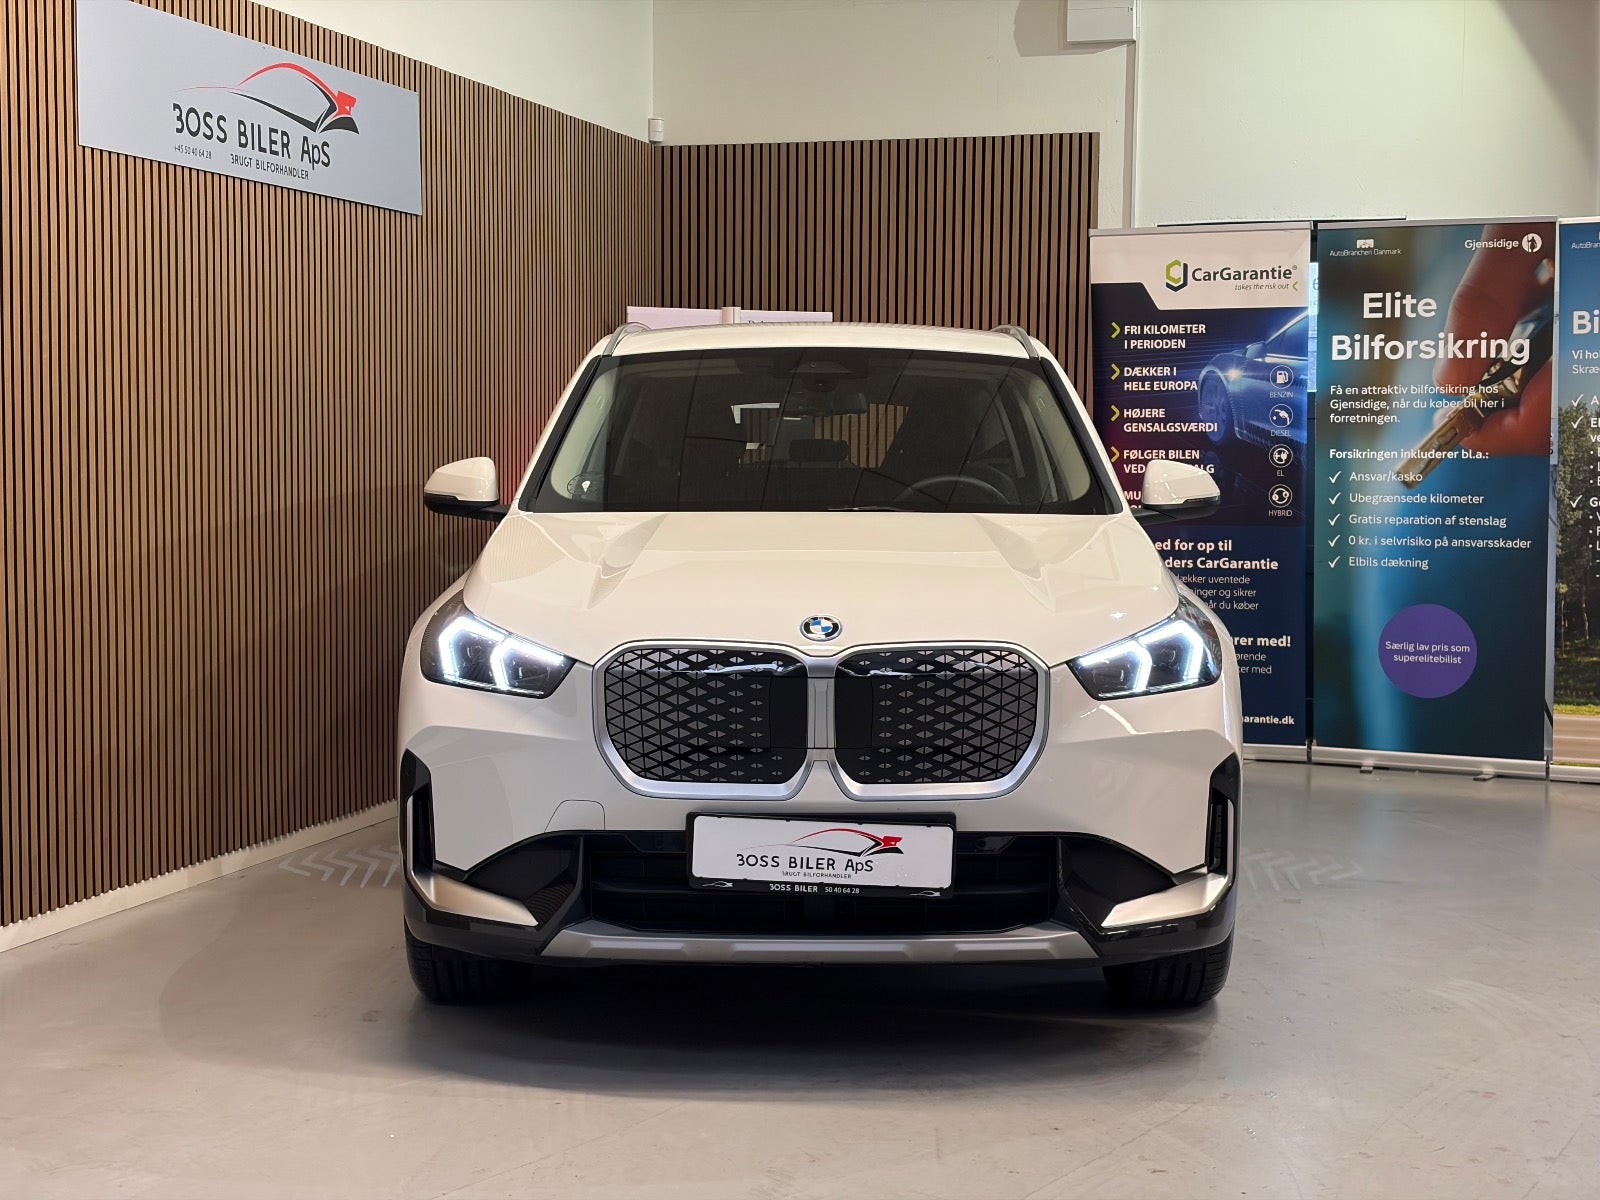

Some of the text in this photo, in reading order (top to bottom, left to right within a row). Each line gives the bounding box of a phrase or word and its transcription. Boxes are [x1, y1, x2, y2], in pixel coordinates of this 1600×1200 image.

[237, 120, 291, 159] BILER
[300, 136, 331, 170] ApS
[191, 148, 198, 157] 40
[198, 149, 205, 158] 64
[205, 151, 212, 160] 28
[255, 160, 309, 180] BILFORHANDLER
[1464, 238, 1519, 250] Gjensidige
[1329, 249, 1373, 257] AutoBranchen
[1363, 291, 1437, 319] Elite
[1124, 324, 1206, 335] FRI KILOMETER
[1130, 339, 1186, 349] PERIODEN
[1331, 331, 1531, 366] Bilforsikring
[1571, 350, 1600, 359] Vi ho
[1123, 367, 1171, 377] DÆKKER
[1572, 365, 1600, 374] Skræ
[1123, 381, 1198, 391] HELE EUROPA
[1330, 384, 1499, 396] Få en attraktiv bilforsikring hos
[1330, 399, 1390, 412] Gjensidige,
[1392, 399, 1411, 409] når
[1413, 399, 1427, 409] du
[1429, 399, 1461, 409] køber
[1464, 399, 1477, 408] bil
[1480, 399, 1499, 408] her
[1123, 409, 1166, 418] HØJERE
[1329, 413, 1401, 425] forretningen.
[1123, 423, 1218, 432] GENSALGSVÆRDI
[1123, 450, 1200, 460] FØLGER BILEN
[1329, 449, 1489, 461] Forsikringen inkluderer bl.a.:
[1123, 464, 1146, 474] VED
[1349, 471, 1423, 482] Ansvar/kasko
[1349, 492, 1485, 505] Ubegrænsede kilometer
[1349, 514, 1507, 529] Gratis reparation af stenslag
[1154, 539, 1233, 554] ed for op til
[1348, 536, 1356, 545] 0
[1358, 536, 1372, 546] kr.
[1380, 536, 1432, 547] selvrisiko
[1434, 536, 1449, 549] på
[1451, 538, 1532, 549] ansvarsskader
[1164, 557, 1279, 570] ders CarGarantie
[1349, 557, 1429, 570] Elbils dækning
[1208, 575, 1251, 584] uventede
[1192, 589, 1257, 600] inger og sikrer
[1219, 601, 1231, 610] du
[1233, 601, 1259, 610] køber
[1230, 635, 1291, 647] rer med!
[1385, 641, 1470, 653] Særlig lav pris som
[1393, 655, 1462, 664] superelitebilist
[1251, 665, 1272, 674] med
[1241, 715, 1295, 725] arantie.dk
[788, 857, 836, 870] BILER
[844, 860, 874, 874] ApS
[794, 885, 818, 893] BILER
